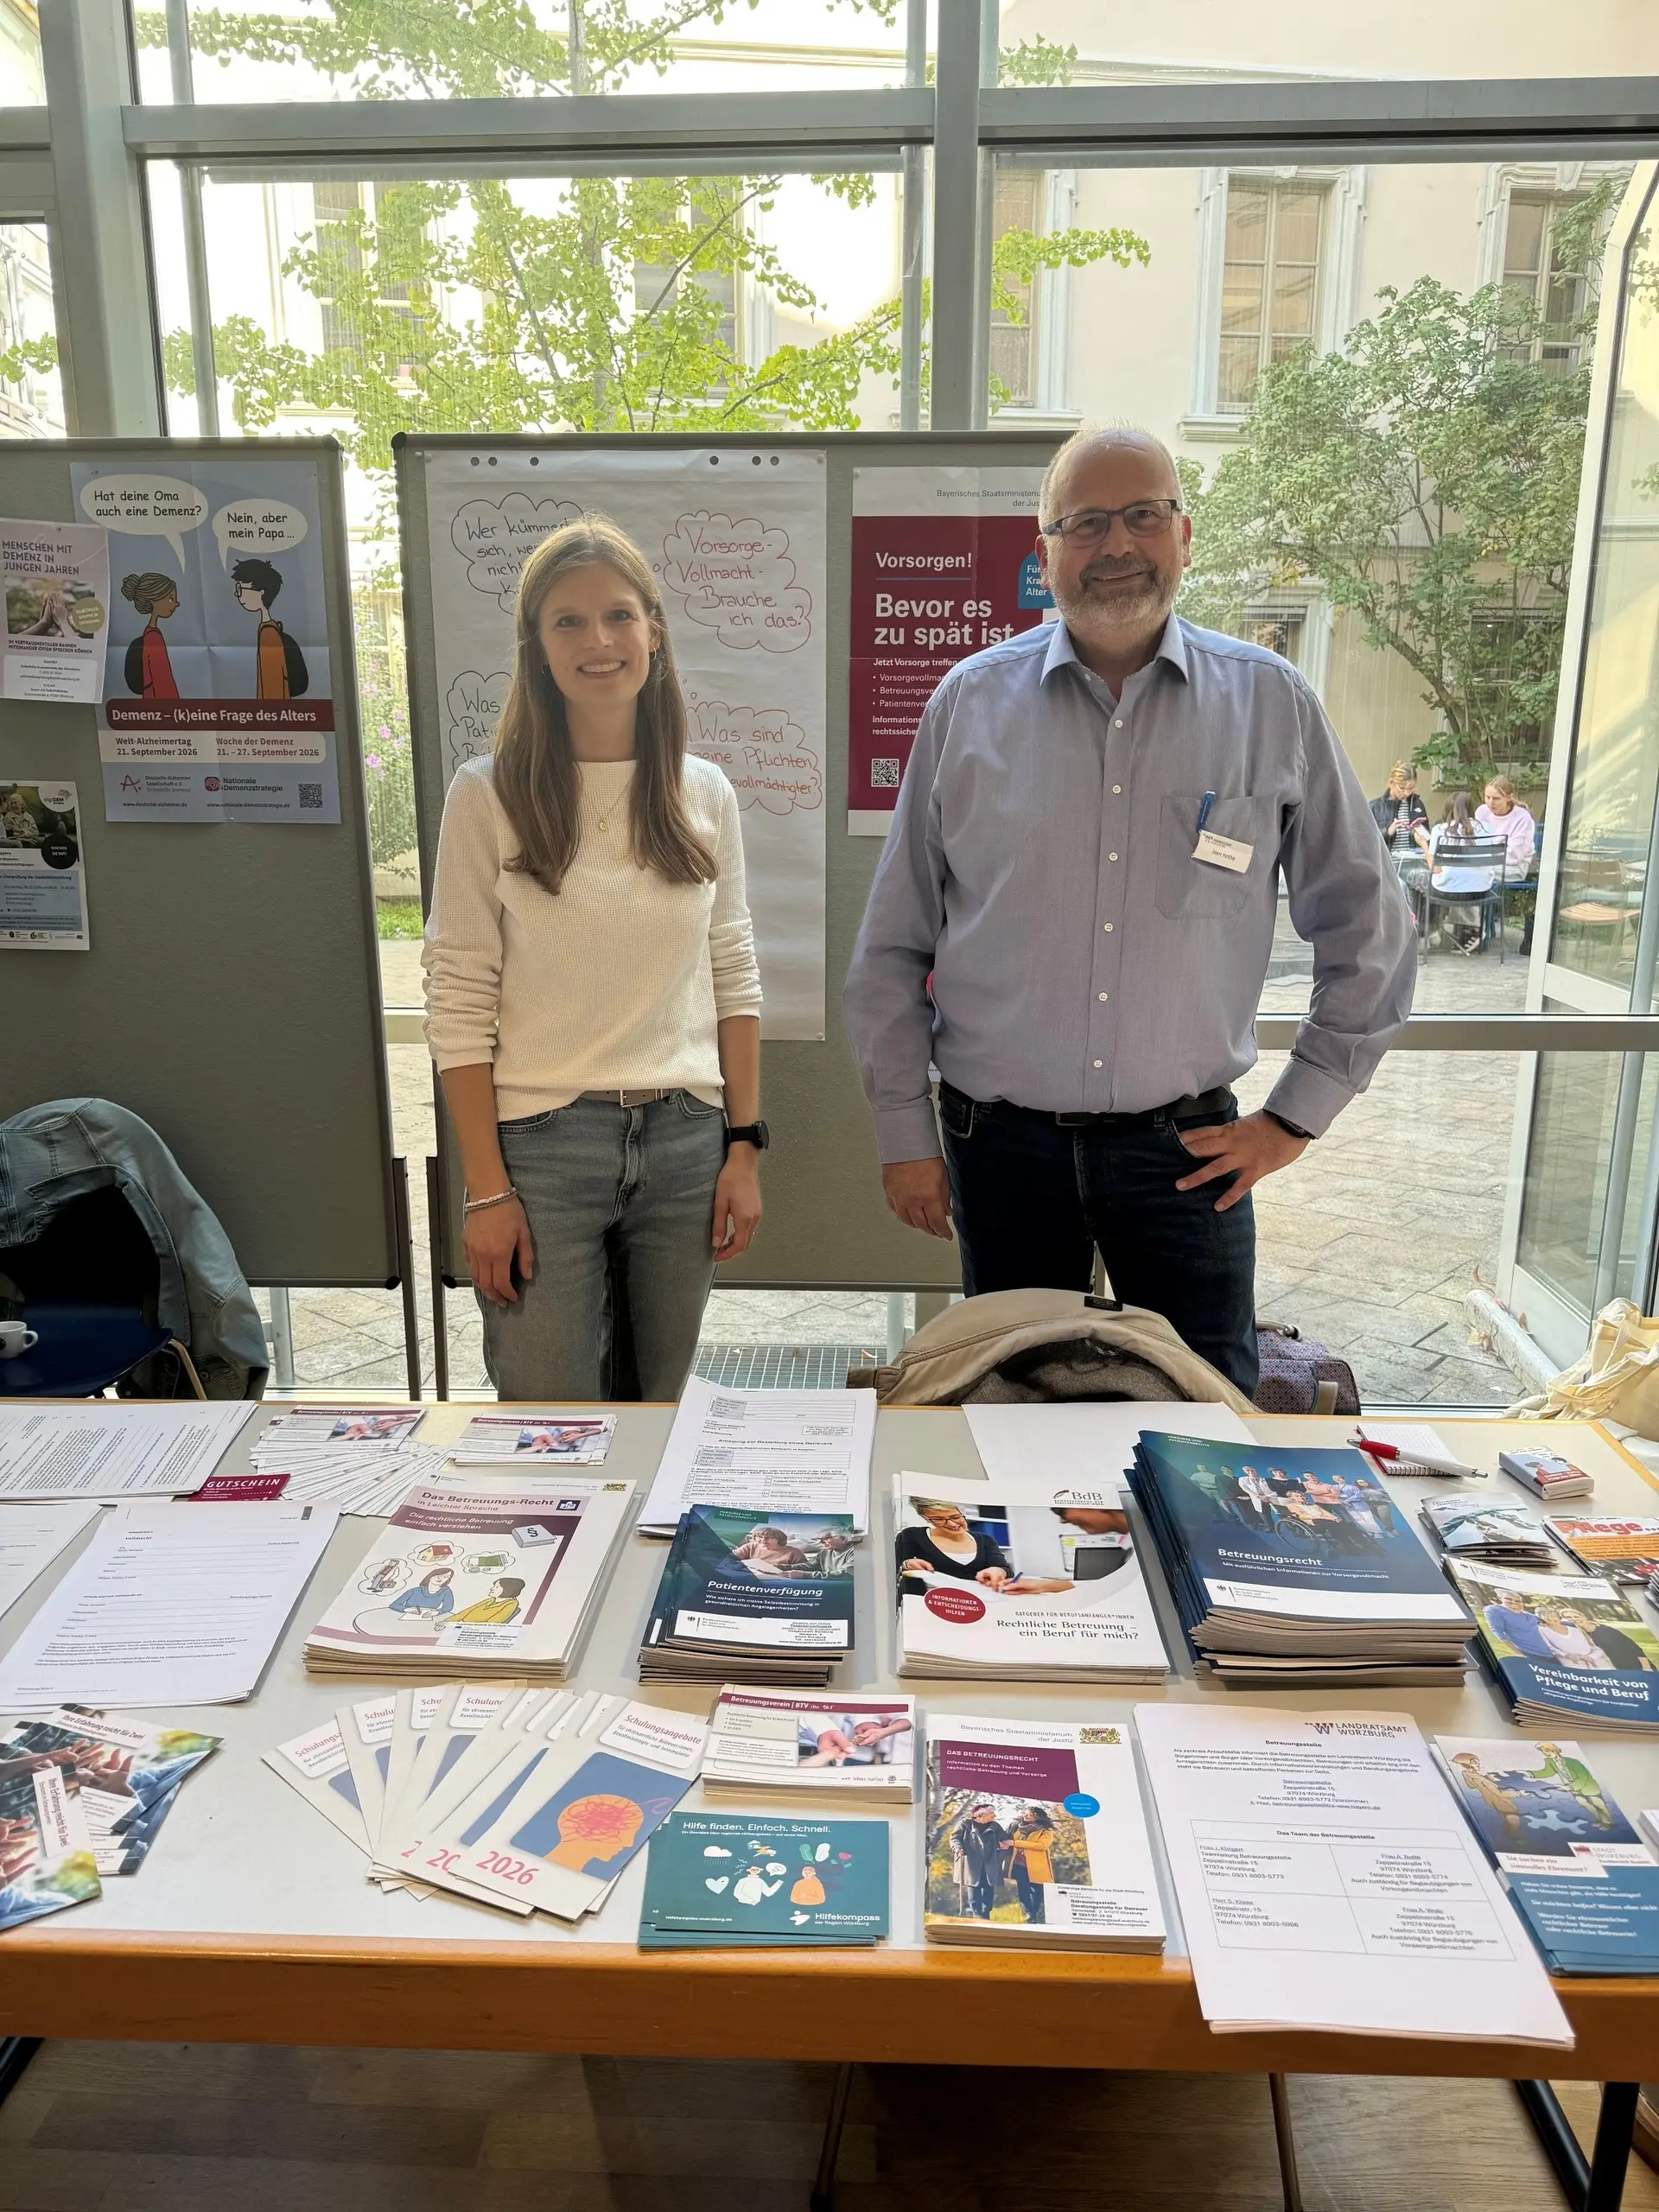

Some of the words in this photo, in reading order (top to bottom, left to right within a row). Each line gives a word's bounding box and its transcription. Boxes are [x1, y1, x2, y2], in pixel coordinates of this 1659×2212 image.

[94, 491, 115, 501] Hat
[120, 491, 149, 501] deine
[155, 491, 179, 501] Oma
[96, 505, 121, 516] auch
[126, 506, 148, 516] eine
[153, 505, 201, 516] Demenz?
[227, 512, 257, 524] Nein,
[262, 513, 287, 523] aber
[229, 529, 255, 538] mein
[258, 528, 284, 540] Papa
[466, 517, 499, 541] Wer
[3, 540, 54, 553] MENSCHEN
[56, 544, 73, 554] MIT
[477, 543, 512, 557] sich,
[3, 551, 41, 563] DEMENZ
[45, 554, 54, 563] IN
[876, 552, 971, 572] Vorsorgen!
[3, 562, 41, 573] JUNGEN
[45, 564, 79, 575] JAHREN
[699, 585, 777, 608] Brauche
[875, 593, 954, 619] Bevor
[962, 599, 992, 618] es
[729, 613, 753, 626] ich
[765, 606, 804, 628] das?
[874, 626, 906, 645] zu
[913, 622, 973, 651] spät
[894, 658, 930, 667] Vorsorge
[461, 688, 500, 713] Was
[112, 709, 162, 721] Demenz
[174, 709, 217, 723] (k)eine
[219, 710, 253, 723] Frage
[256, 709, 277, 721] des
[280, 710, 316, 721] Alters
[697, 715, 741, 742] Was
[749, 726, 785, 743] sind
[116, 737, 192, 747] Welt-Alzheimertag
[216, 737, 243, 746] Woche
[245, 737, 258, 746] der
[130, 748, 176, 758] September
[251, 748, 298, 758] September
[741, 746, 812, 771] Pflichten
[207, 1478, 281, 1489] GUTSCHEIN
[448, 1495, 554, 1505] Betreuungs-Recht
[1071, 1491, 1103, 1500] BdB
[1218, 1548, 1322, 1566] Betreuungsrecht
[708, 1580, 823, 1597] Patientenverfügung
[931, 1594, 977, 1605] INFORMATIONEN
[996, 1620, 1057, 1629] Rechtliche
[1062, 1621, 1124, 1631] Betreuung
[1103, 1631, 1139, 1640] mich?
[1528, 1663, 1620, 1687] Vereinbarkeit
[1535, 1675, 1579, 1691] Pflege
[1581, 1685, 1608, 1695] und
[1611, 1688, 1649, 1700] Beruf
[731, 1696, 790, 1708] Betreuungsverein
[625, 1714, 702, 1745] Schulungsangebote
[1335, 1723, 1408, 1733] LANDRATSAMT
[1338, 1728, 1395, 1738] WÜRZBURG
[963, 1751, 1039, 1762] BETREUUNGSRECHT
[709, 1822, 744, 1831] finden.
[747, 1823, 788, 1832] Einfach.
[476, 1851, 540, 1885] 2026
[815, 1912, 880, 1922] Hilfekompass
